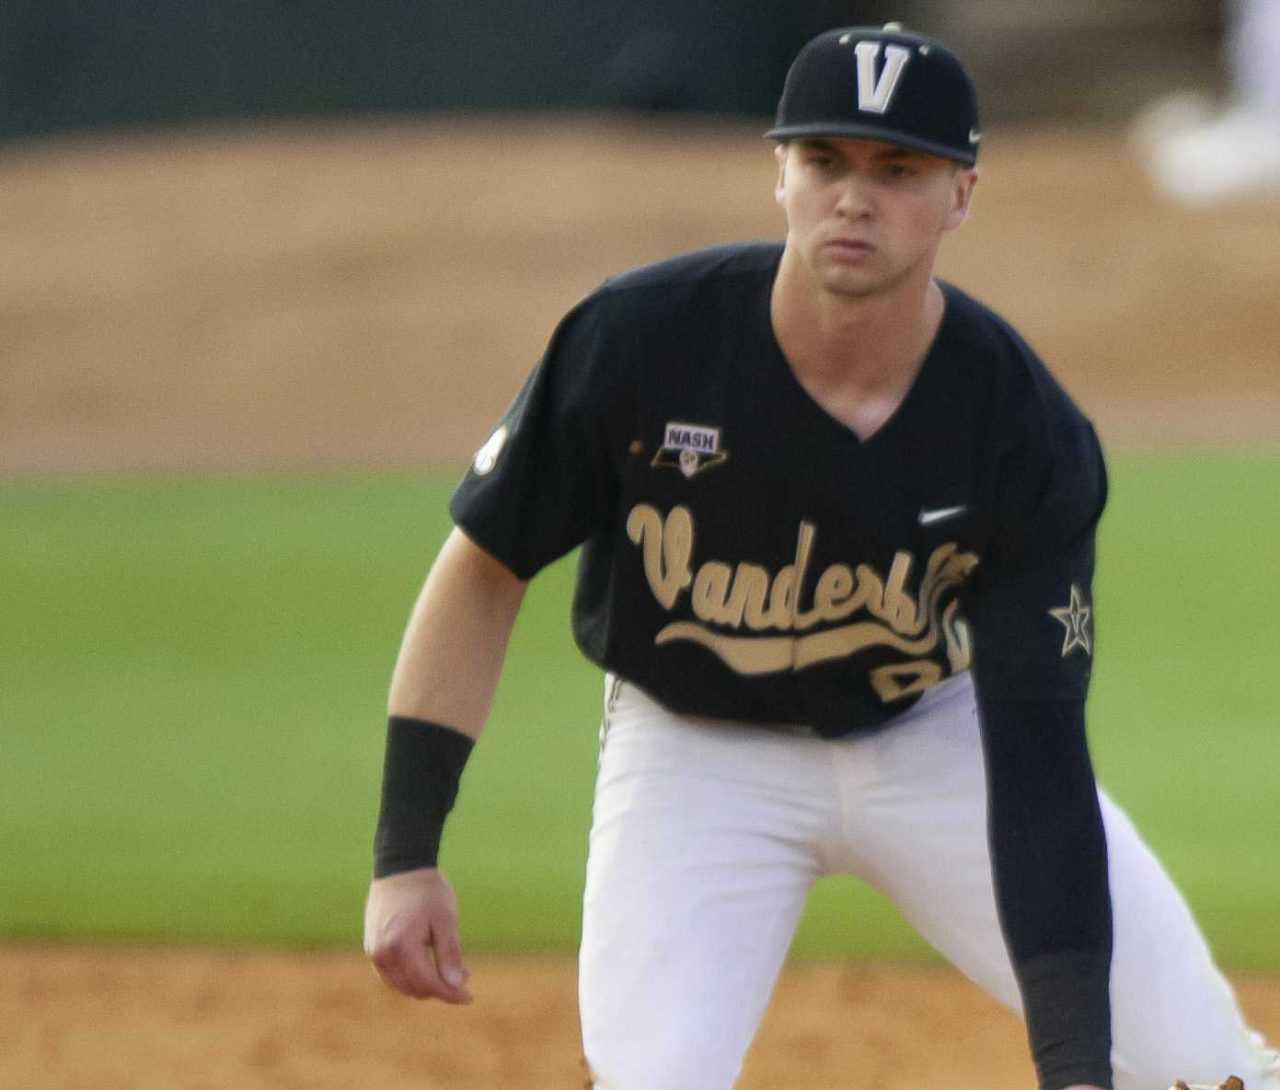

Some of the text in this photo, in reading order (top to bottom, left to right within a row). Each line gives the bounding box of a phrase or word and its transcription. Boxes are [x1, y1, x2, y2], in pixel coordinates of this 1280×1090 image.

[854, 40, 910, 114] V
[668, 430, 715, 450] NASH
[626, 503, 979, 637] Vanderb
